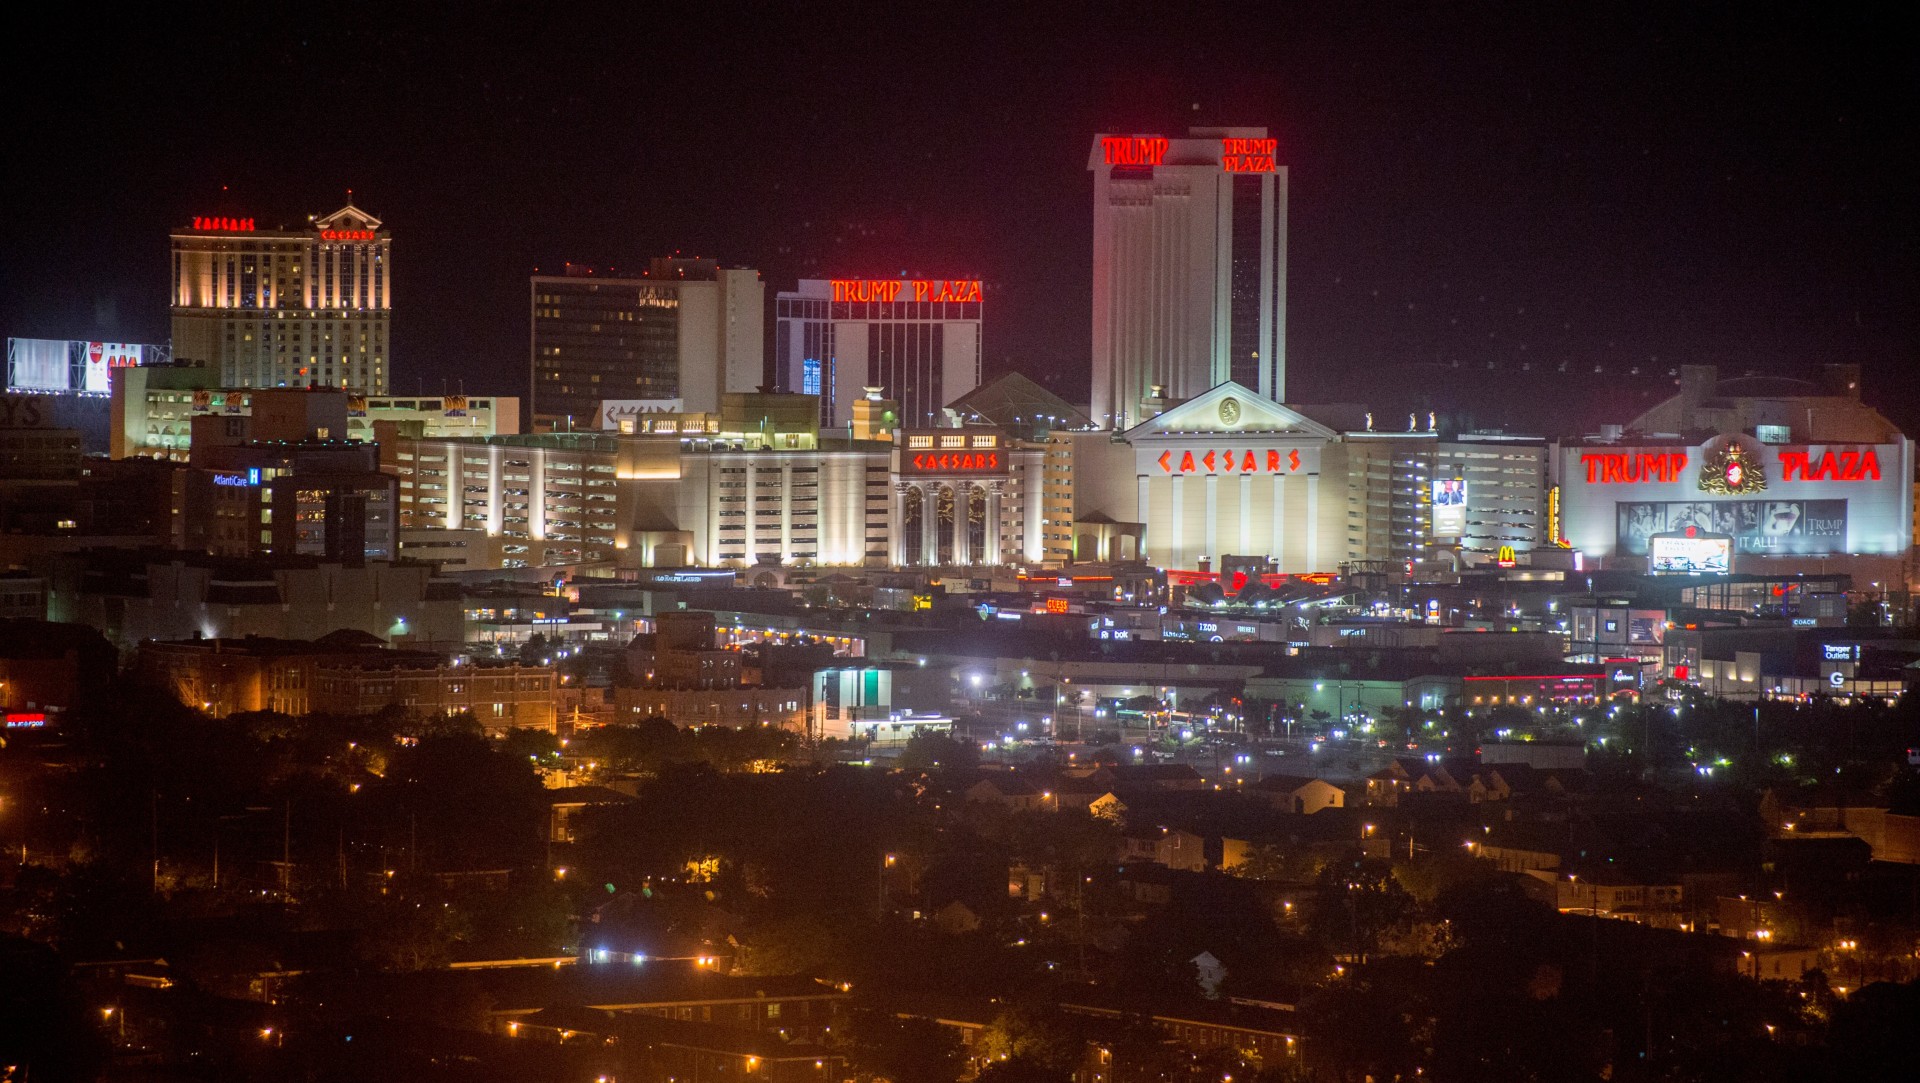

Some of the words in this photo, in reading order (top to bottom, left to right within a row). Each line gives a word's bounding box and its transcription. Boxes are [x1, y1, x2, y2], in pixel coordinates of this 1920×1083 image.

[1102, 136, 1169, 166] TRUMP
[1222, 138, 1277, 154] TRUMP
[1222, 155, 1276, 172] PLAZA
[194, 217, 255, 231] CAESARS
[321, 230, 375, 240] CAESARS
[831, 279, 902, 303] TRUMP
[912, 279, 983, 303] PLAZA
[914, 453, 998, 470] CAESARS
[1158, 449, 1301, 472] CAESARS
[1581, 453, 1689, 484] TRUMP
[1778, 452, 1882, 481] PLAZA
[214, 475, 247, 487] AtlantiCare
[250, 468, 259, 484] H
[1808, 518, 1842, 531] TRUMP
[1740, 537, 1750, 549] IT
[1753, 537, 1778, 549] ALL!
[1047, 599, 1067, 609] GUESS
[1199, 623, 1218, 632] IZOD
[1824, 645, 1851, 653] Tanger
[1825, 652, 1850, 660] Outlets
